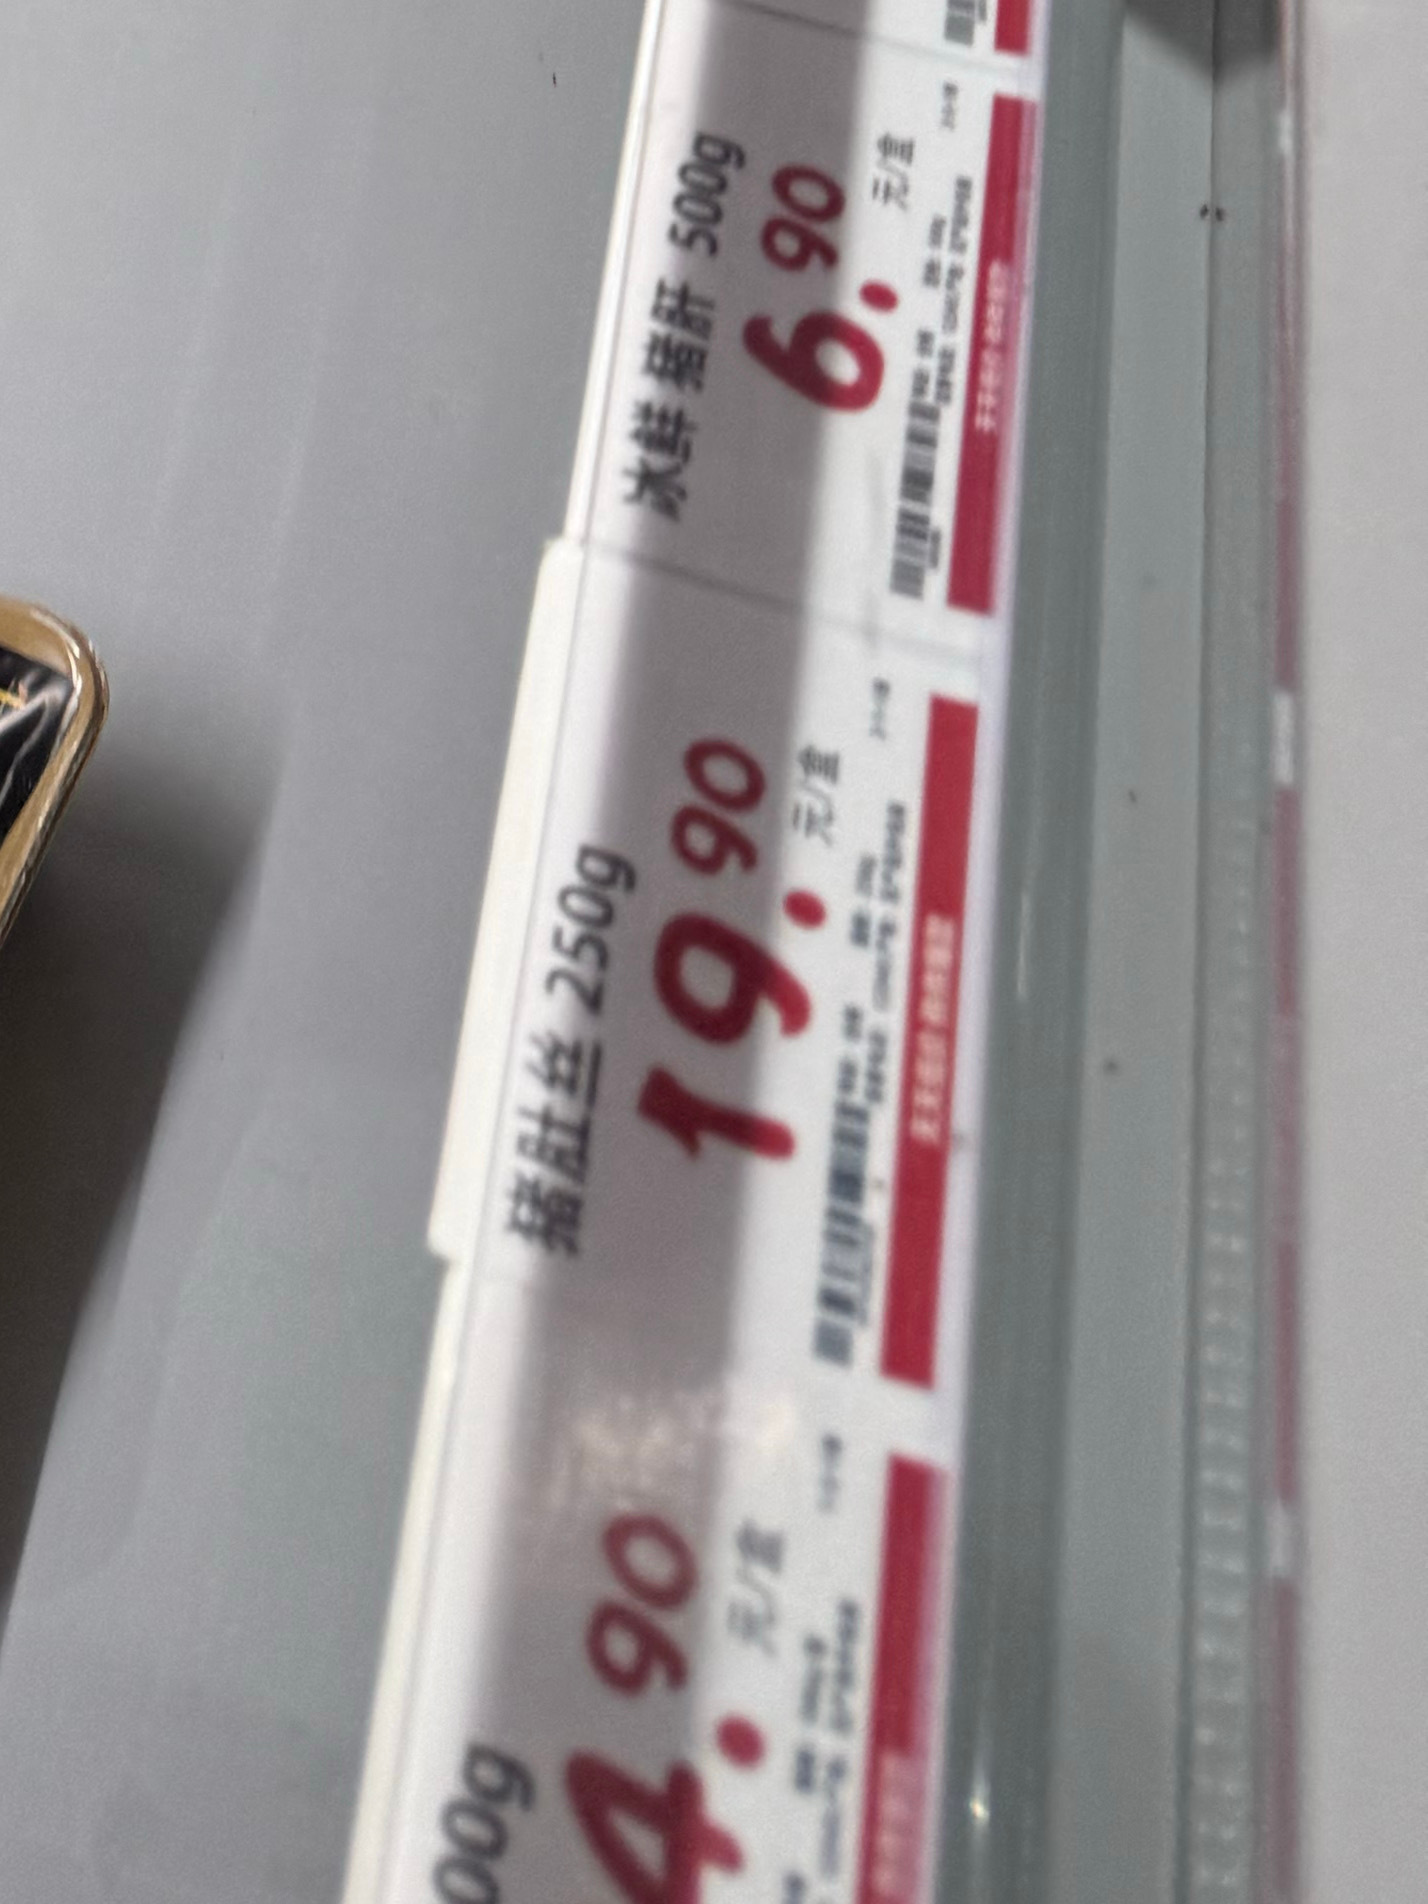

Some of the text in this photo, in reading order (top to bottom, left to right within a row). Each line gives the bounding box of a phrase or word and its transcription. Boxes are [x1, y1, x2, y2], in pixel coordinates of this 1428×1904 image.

[624, 130, 747, 524] 冰鲜 猪肝 500g
[742, 164, 900, 415] 6.90
[872, 130, 916, 212] 元/盒
[636, 737, 828, 1162] 19.90
[791, 744, 842, 850] 元/盒
[506, 843, 637, 1260] 猪肚丝 250g
